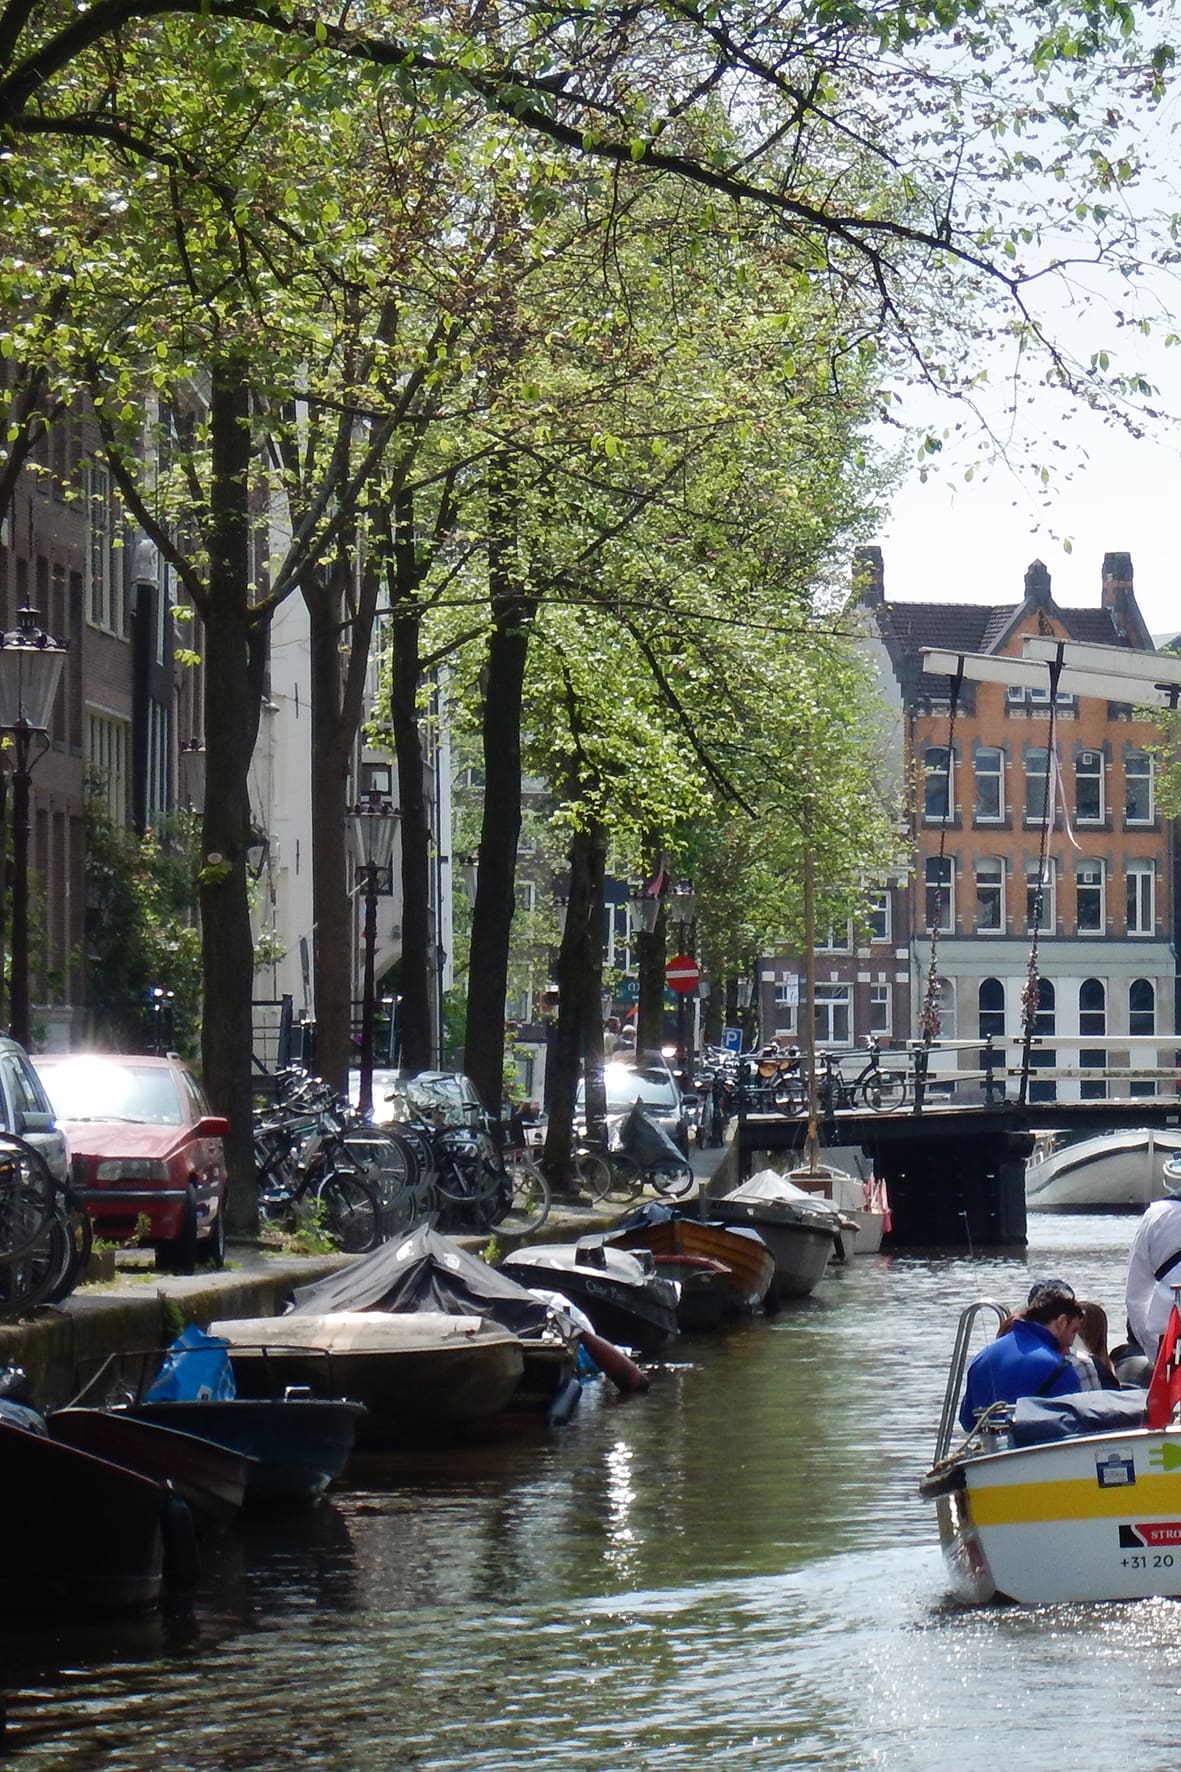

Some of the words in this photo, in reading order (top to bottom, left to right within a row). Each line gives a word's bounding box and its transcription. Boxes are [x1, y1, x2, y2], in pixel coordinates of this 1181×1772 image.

[726, 1031, 738, 1046] P
[1121, 1555, 1147, 1569] +31
[1153, 1554, 1174, 1568] 20
